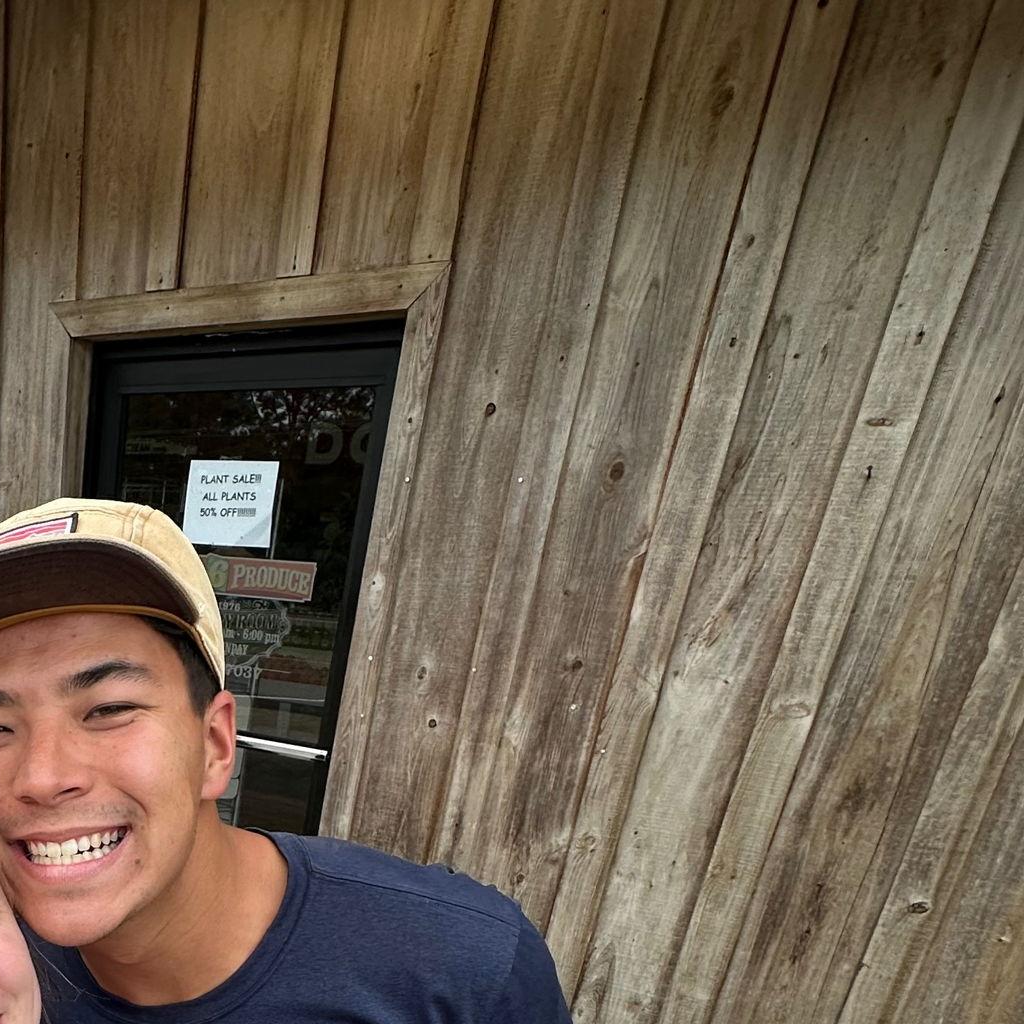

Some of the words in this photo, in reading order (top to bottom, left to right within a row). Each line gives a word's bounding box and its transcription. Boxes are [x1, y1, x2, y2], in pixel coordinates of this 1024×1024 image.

[200, 474, 229, 485] PLANT
[202, 492, 217, 501] ALL
[221, 491, 257, 501] PLANTS
[200, 507, 217, 517] 50%
[231, 564, 310, 595] PRODUCE
[242, 628, 264, 641] 6:00
